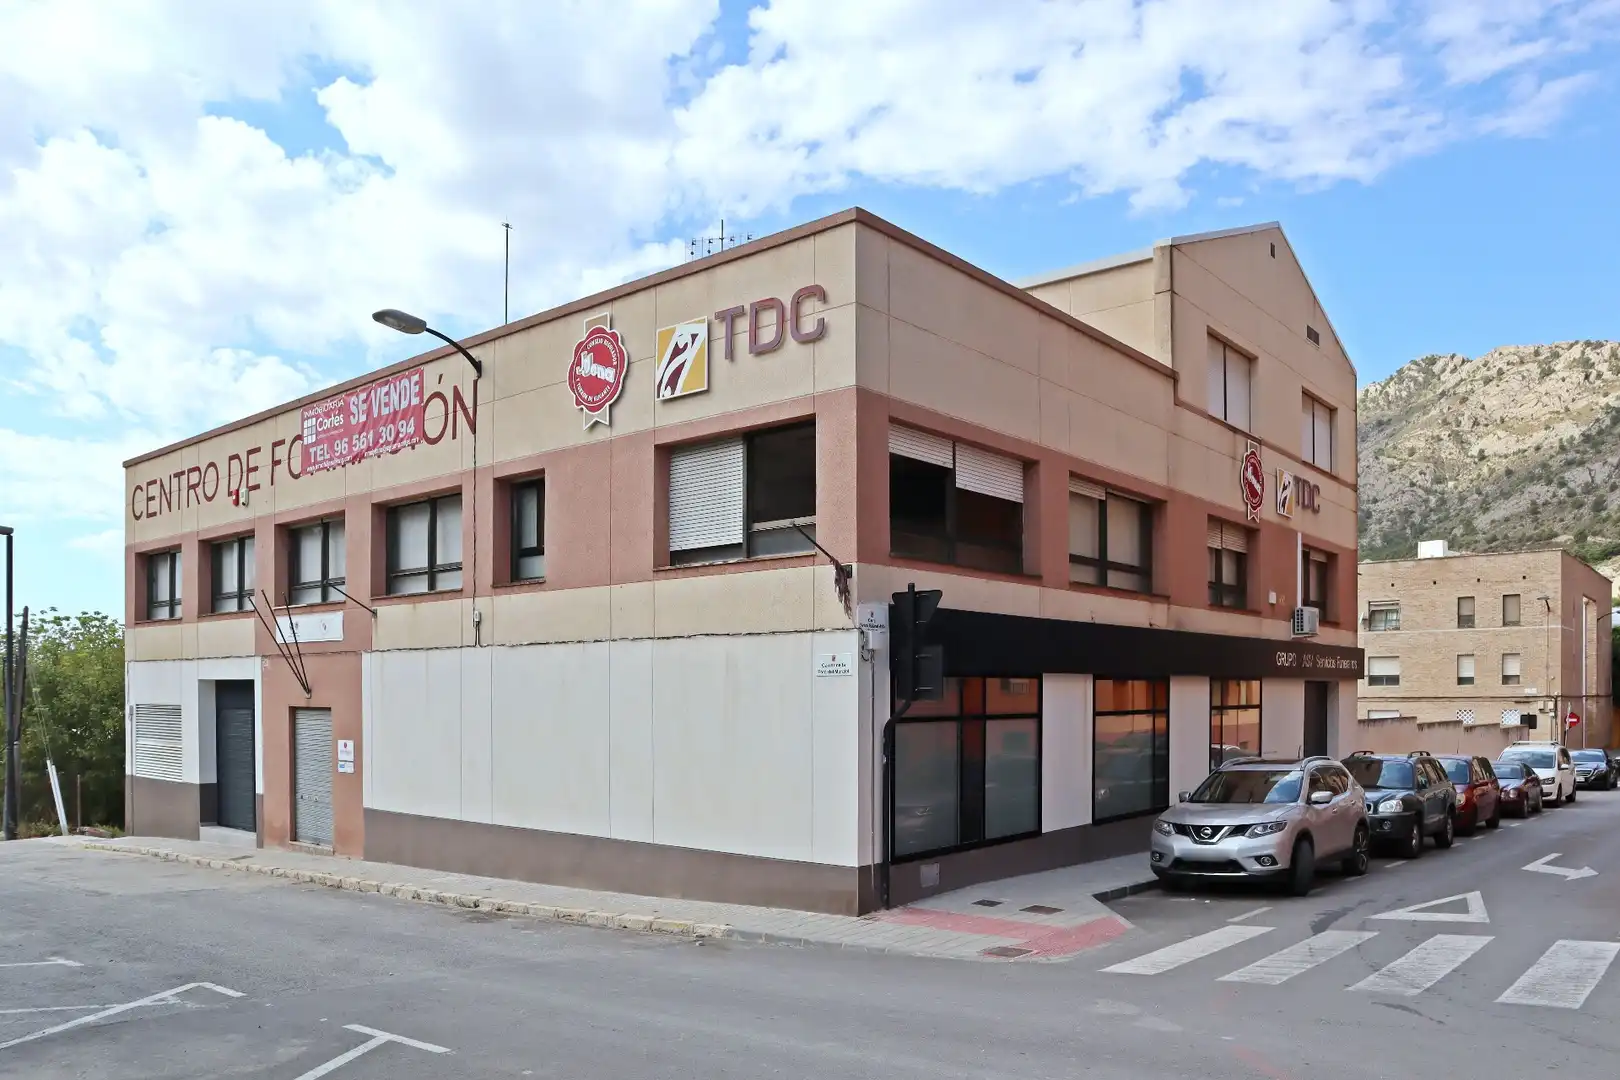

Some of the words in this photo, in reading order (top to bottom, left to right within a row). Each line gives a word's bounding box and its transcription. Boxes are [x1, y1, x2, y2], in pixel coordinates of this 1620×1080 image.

[714, 284, 825, 361] TDC
[317, 410, 344, 432] Cortés
[349, 392, 367, 425] SE
[370, 374, 420, 418] VENDE
[309, 443, 331, 462] TEL
[334, 438, 349, 456] 96
[352, 430, 374, 452] 561
[378, 424, 395, 443] 30
[398, 417, 415, 437] 94
[132, 462, 219, 521] CENTRO
[227, 447, 261, 498] DE
[1293, 474, 1320, 514] TDC
